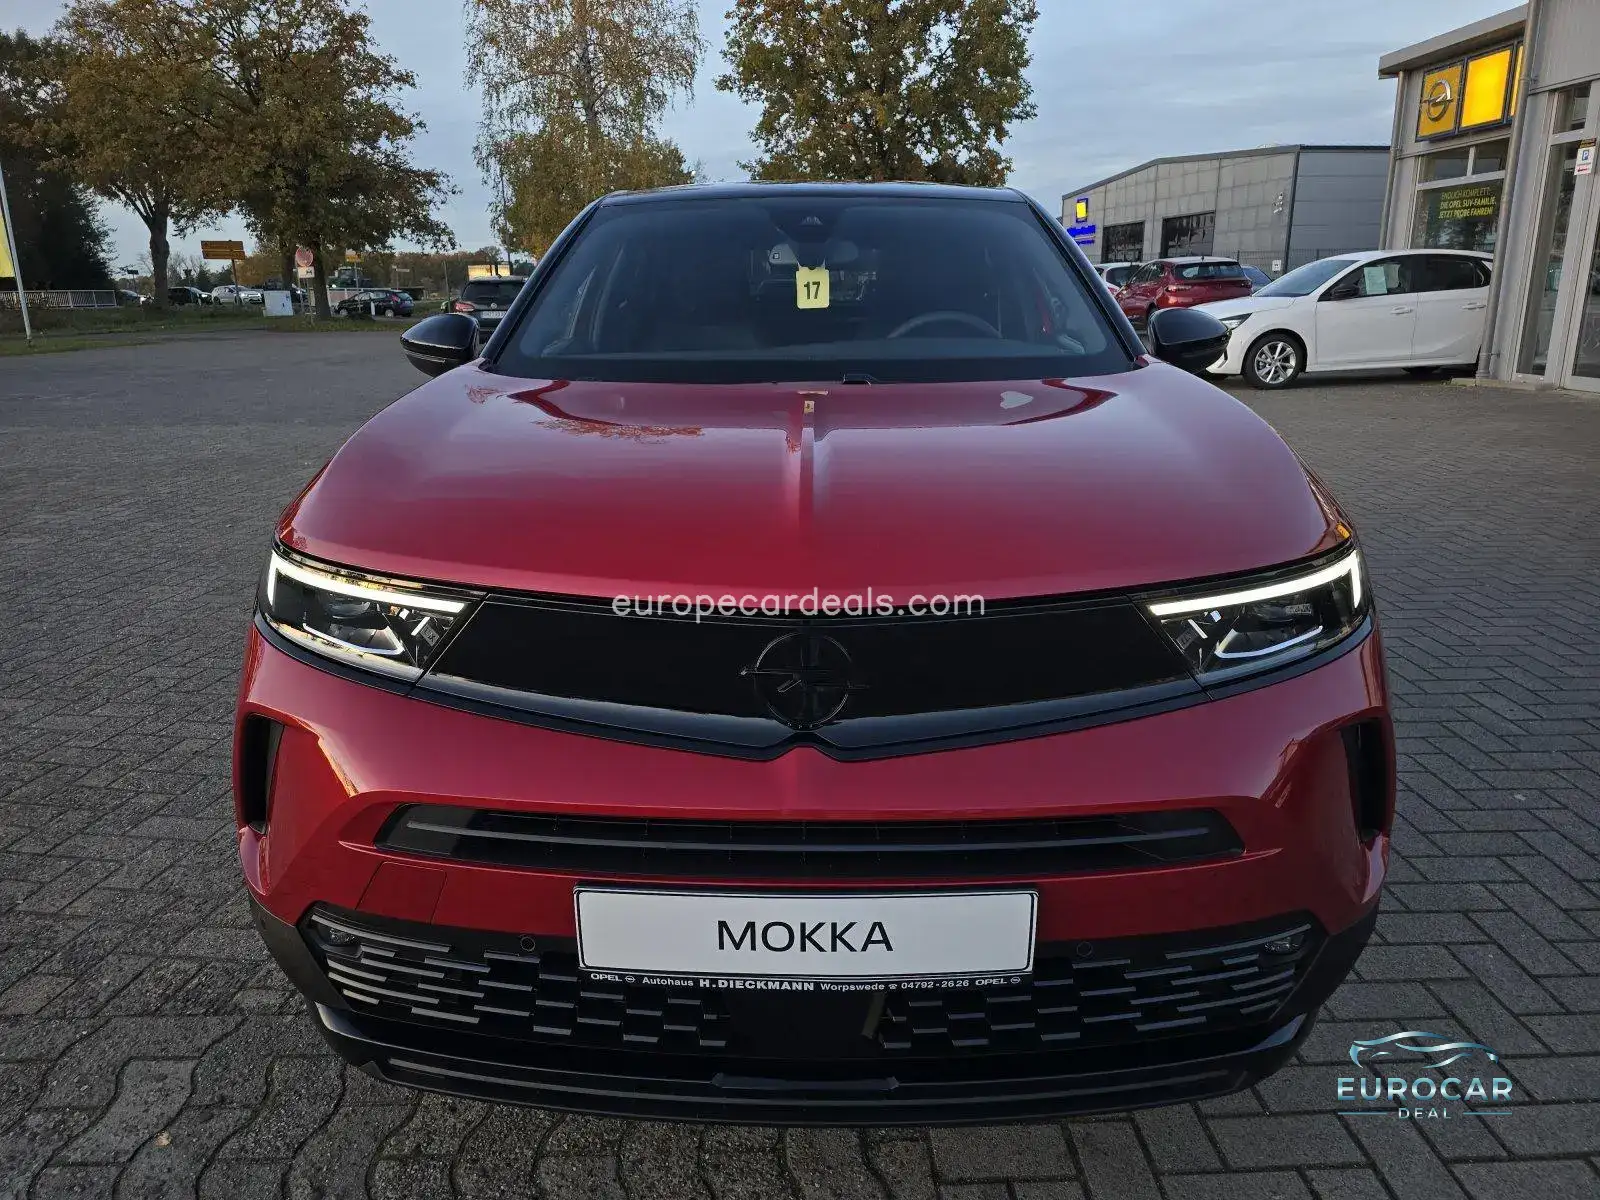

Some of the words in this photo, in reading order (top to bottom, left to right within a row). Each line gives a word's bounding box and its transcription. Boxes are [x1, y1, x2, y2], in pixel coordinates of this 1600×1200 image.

[1449, 200, 1462, 208] OPEL
[804, 281, 821, 300] 17
[717, 920, 894, 952] MOKKA
[590, 973, 622, 982] OPEL
[642, 976, 694, 987] Autohaus
[700, 979, 814, 991] H.DIECKMANN
[820, 982, 885, 992] Worpswede
[975, 977, 1007, 986] OPEL
